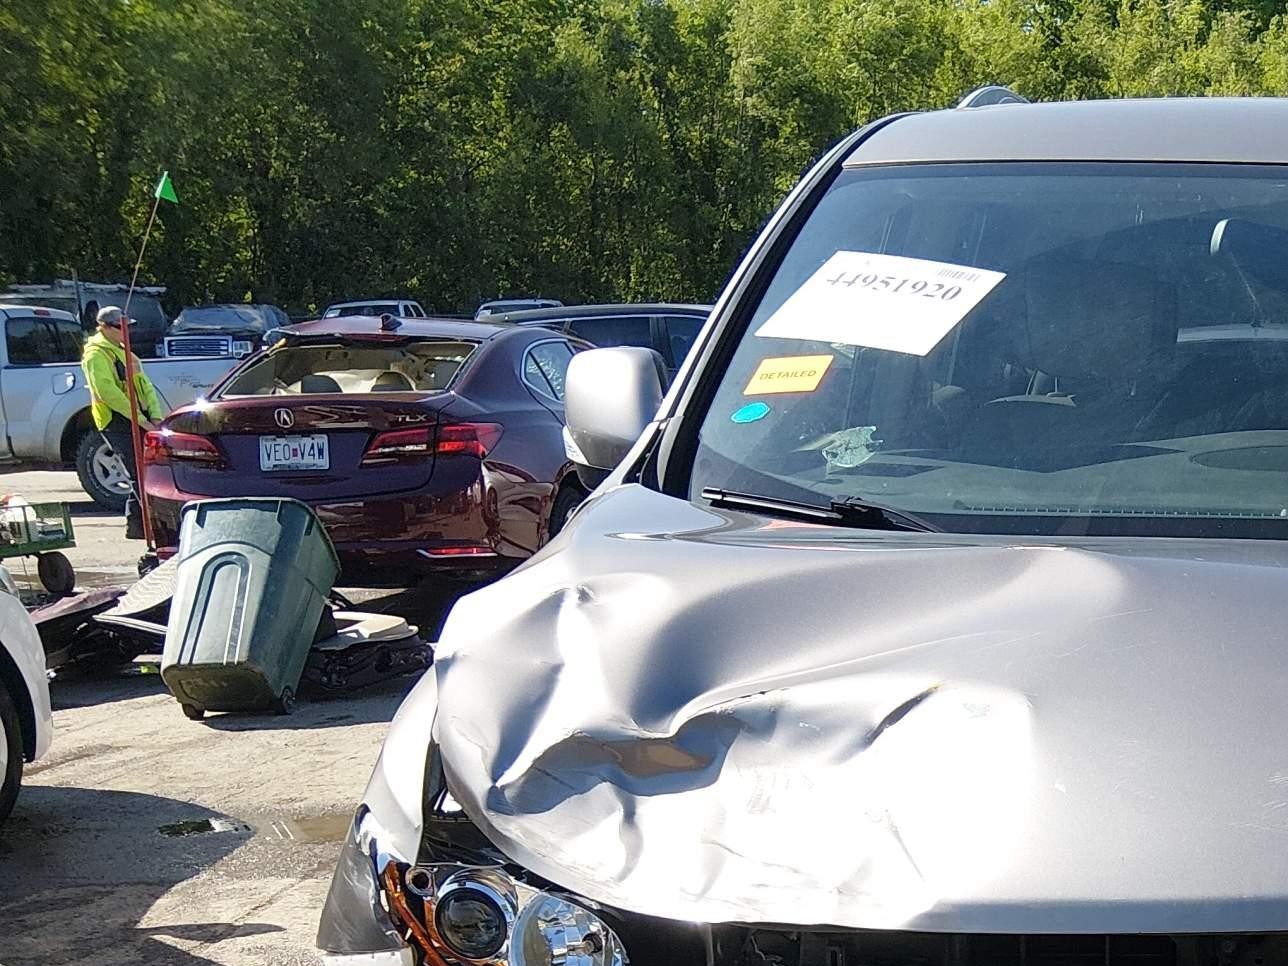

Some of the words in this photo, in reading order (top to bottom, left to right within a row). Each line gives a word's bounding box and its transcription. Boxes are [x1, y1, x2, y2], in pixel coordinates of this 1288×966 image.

[826, 271, 962, 301] 44951920
[759, 369, 817, 380] DETAILED
[395, 414, 428, 423] TLX
[298, 442, 325, 461] V4W
